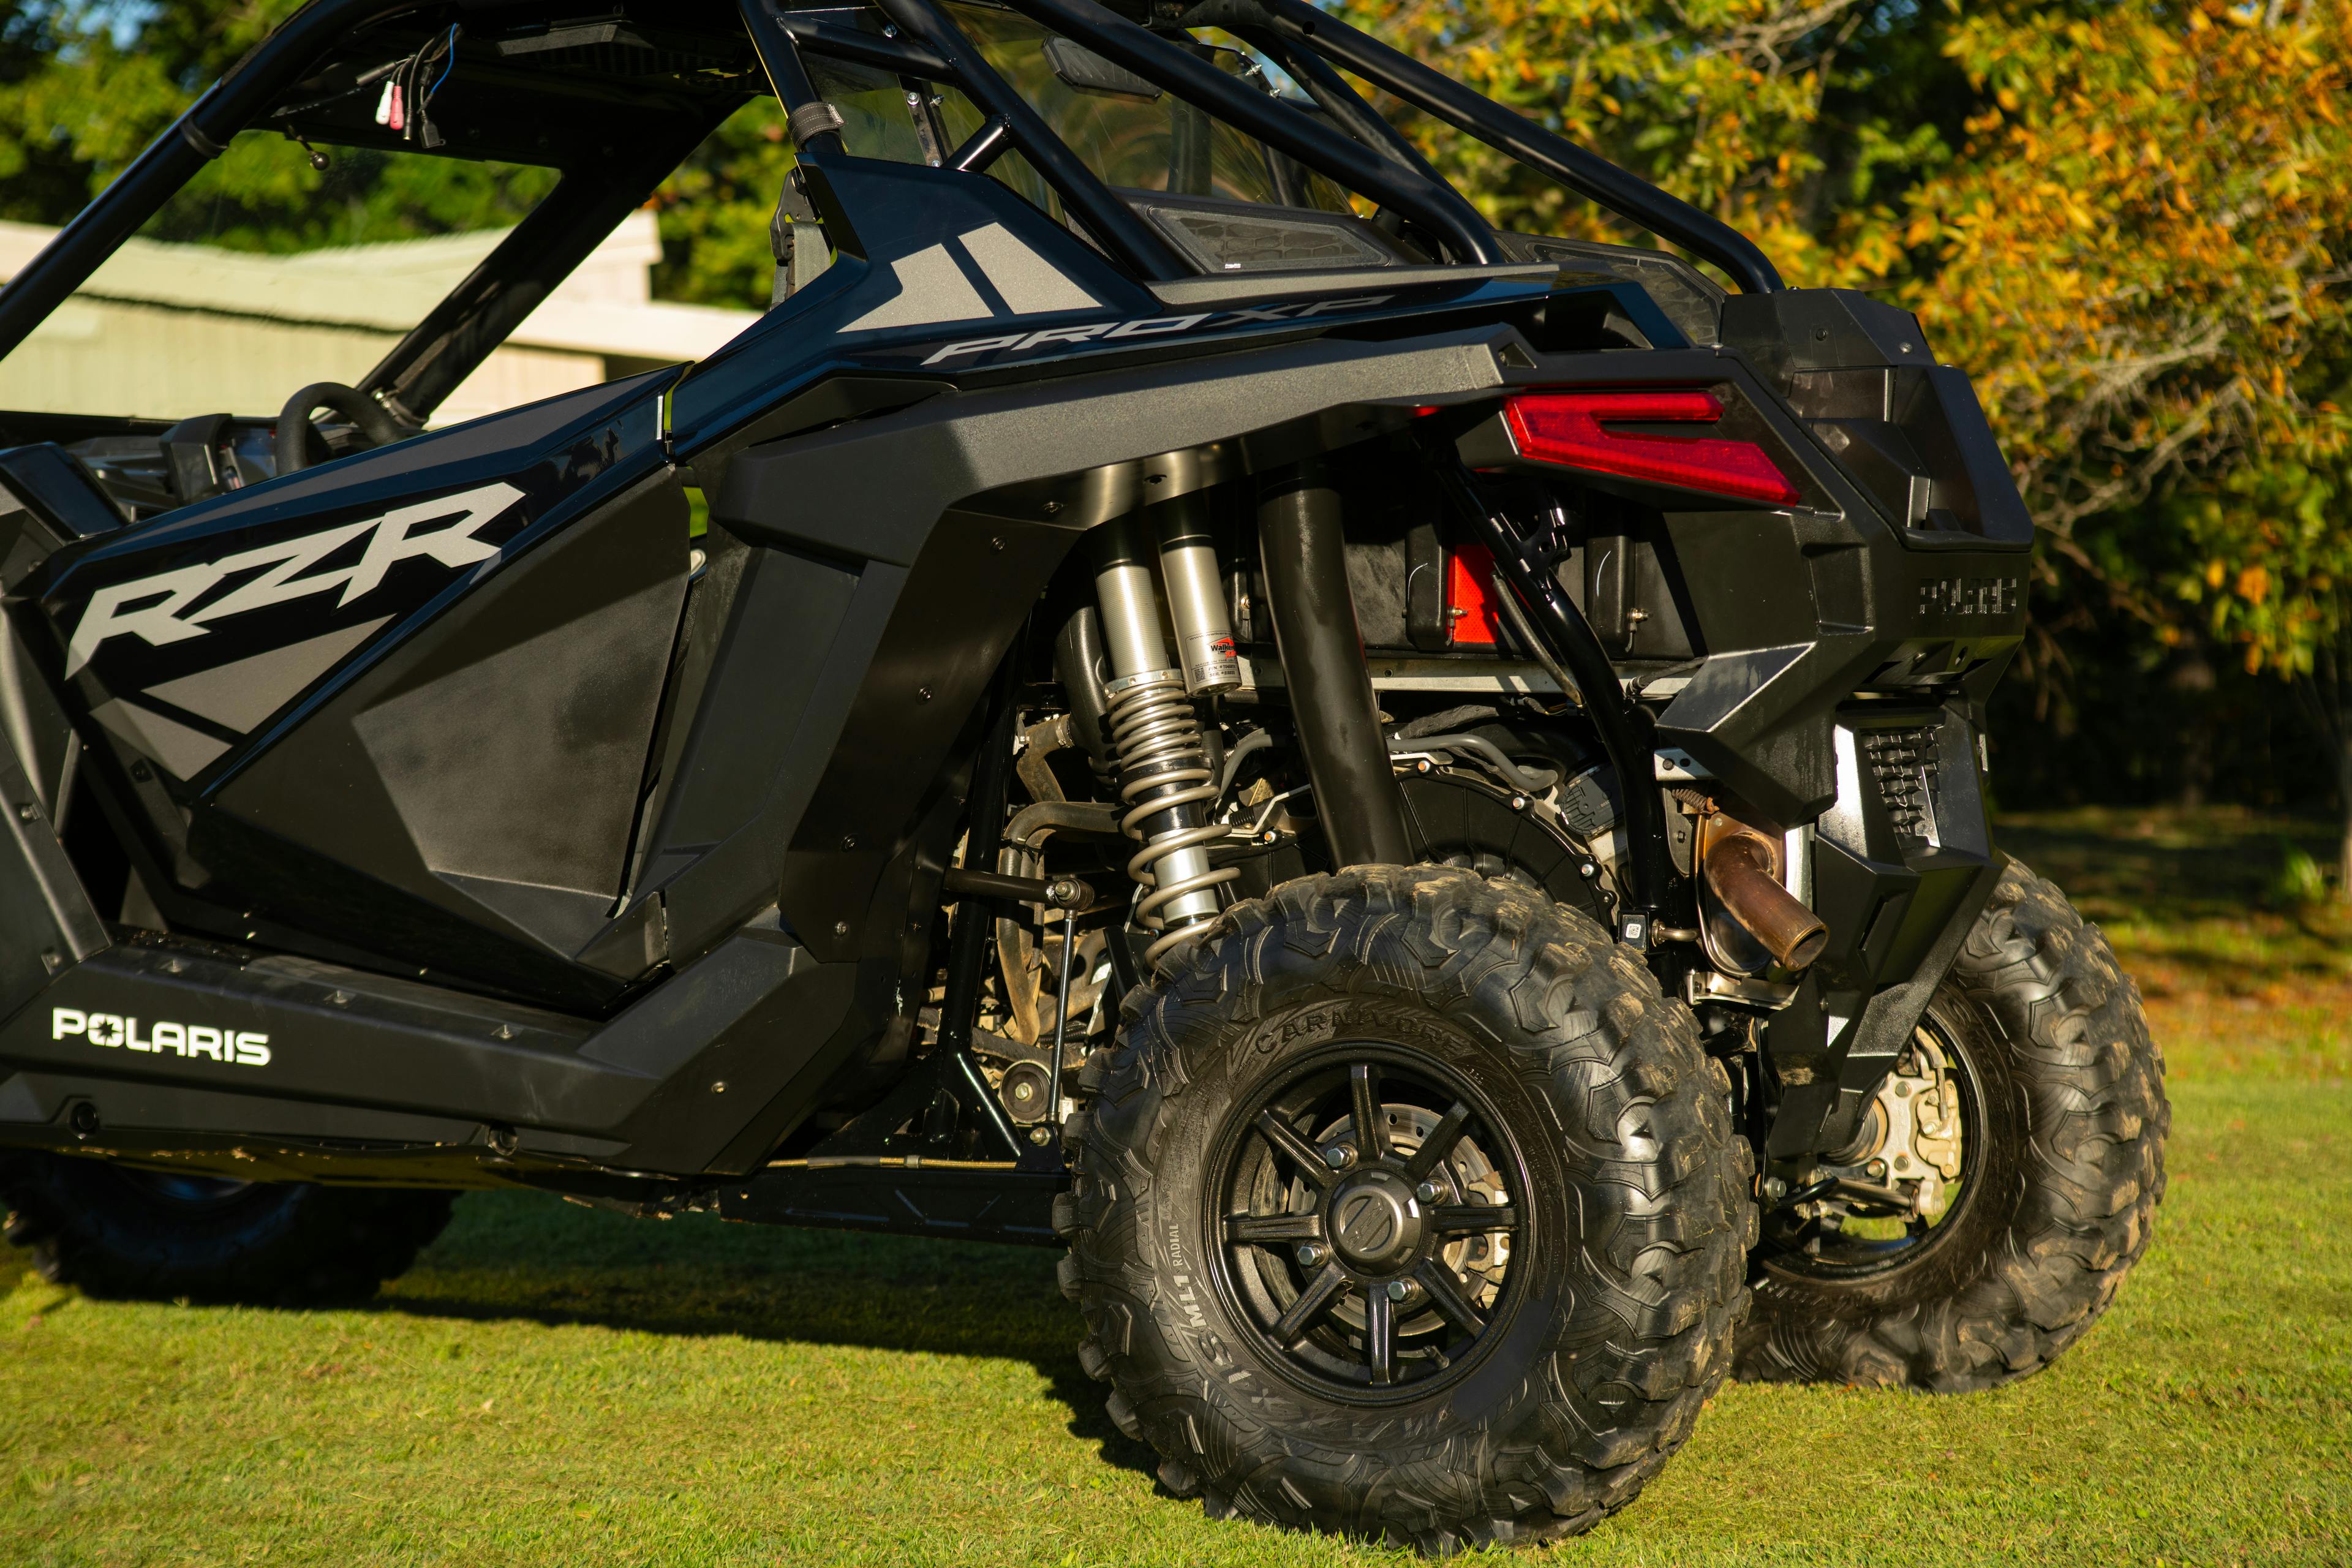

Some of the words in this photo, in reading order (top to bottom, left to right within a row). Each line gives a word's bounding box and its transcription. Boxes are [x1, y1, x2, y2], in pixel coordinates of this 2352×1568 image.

[919, 313, 1213, 366] PRO
[1202, 295, 1396, 327] XP
[64, 482, 527, 680] RZR
[53, 1007, 271, 1066] POLARIS
[1255, 1008, 1462, 1056] CARNIVORE
[1169, 1223, 1184, 1267] RADIAL
[1174, 1275, 1207, 1328] ML1
